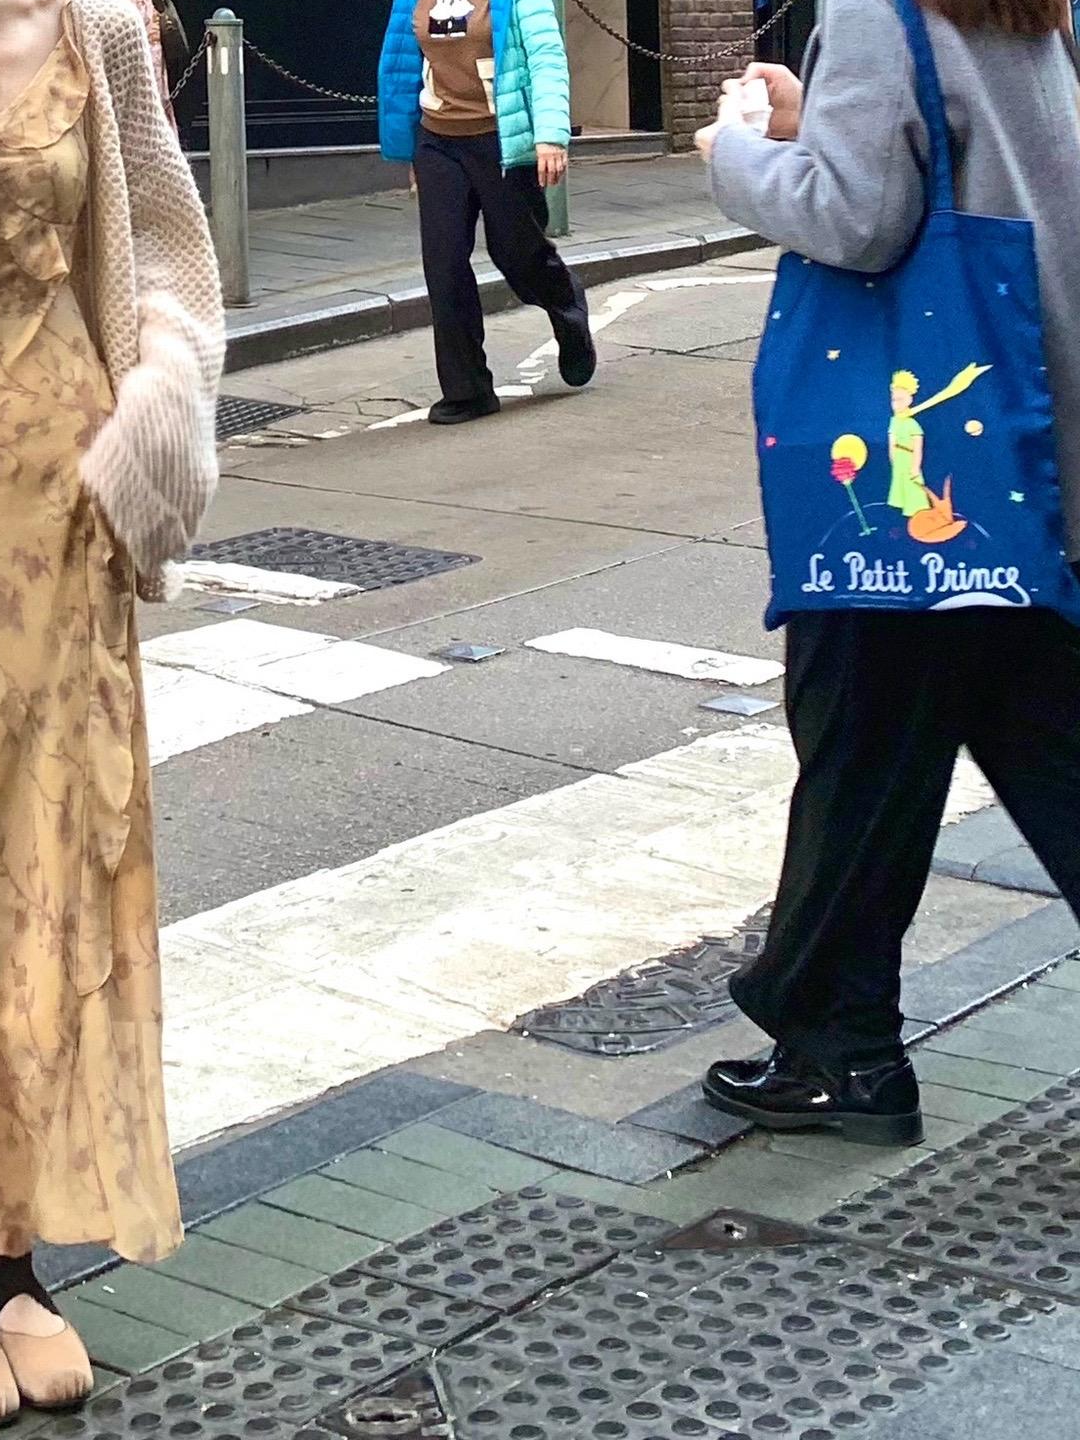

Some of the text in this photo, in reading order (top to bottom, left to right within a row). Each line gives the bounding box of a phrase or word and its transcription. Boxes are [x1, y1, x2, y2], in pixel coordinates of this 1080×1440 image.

[801, 551, 1026, 597] Le Petit Prince
